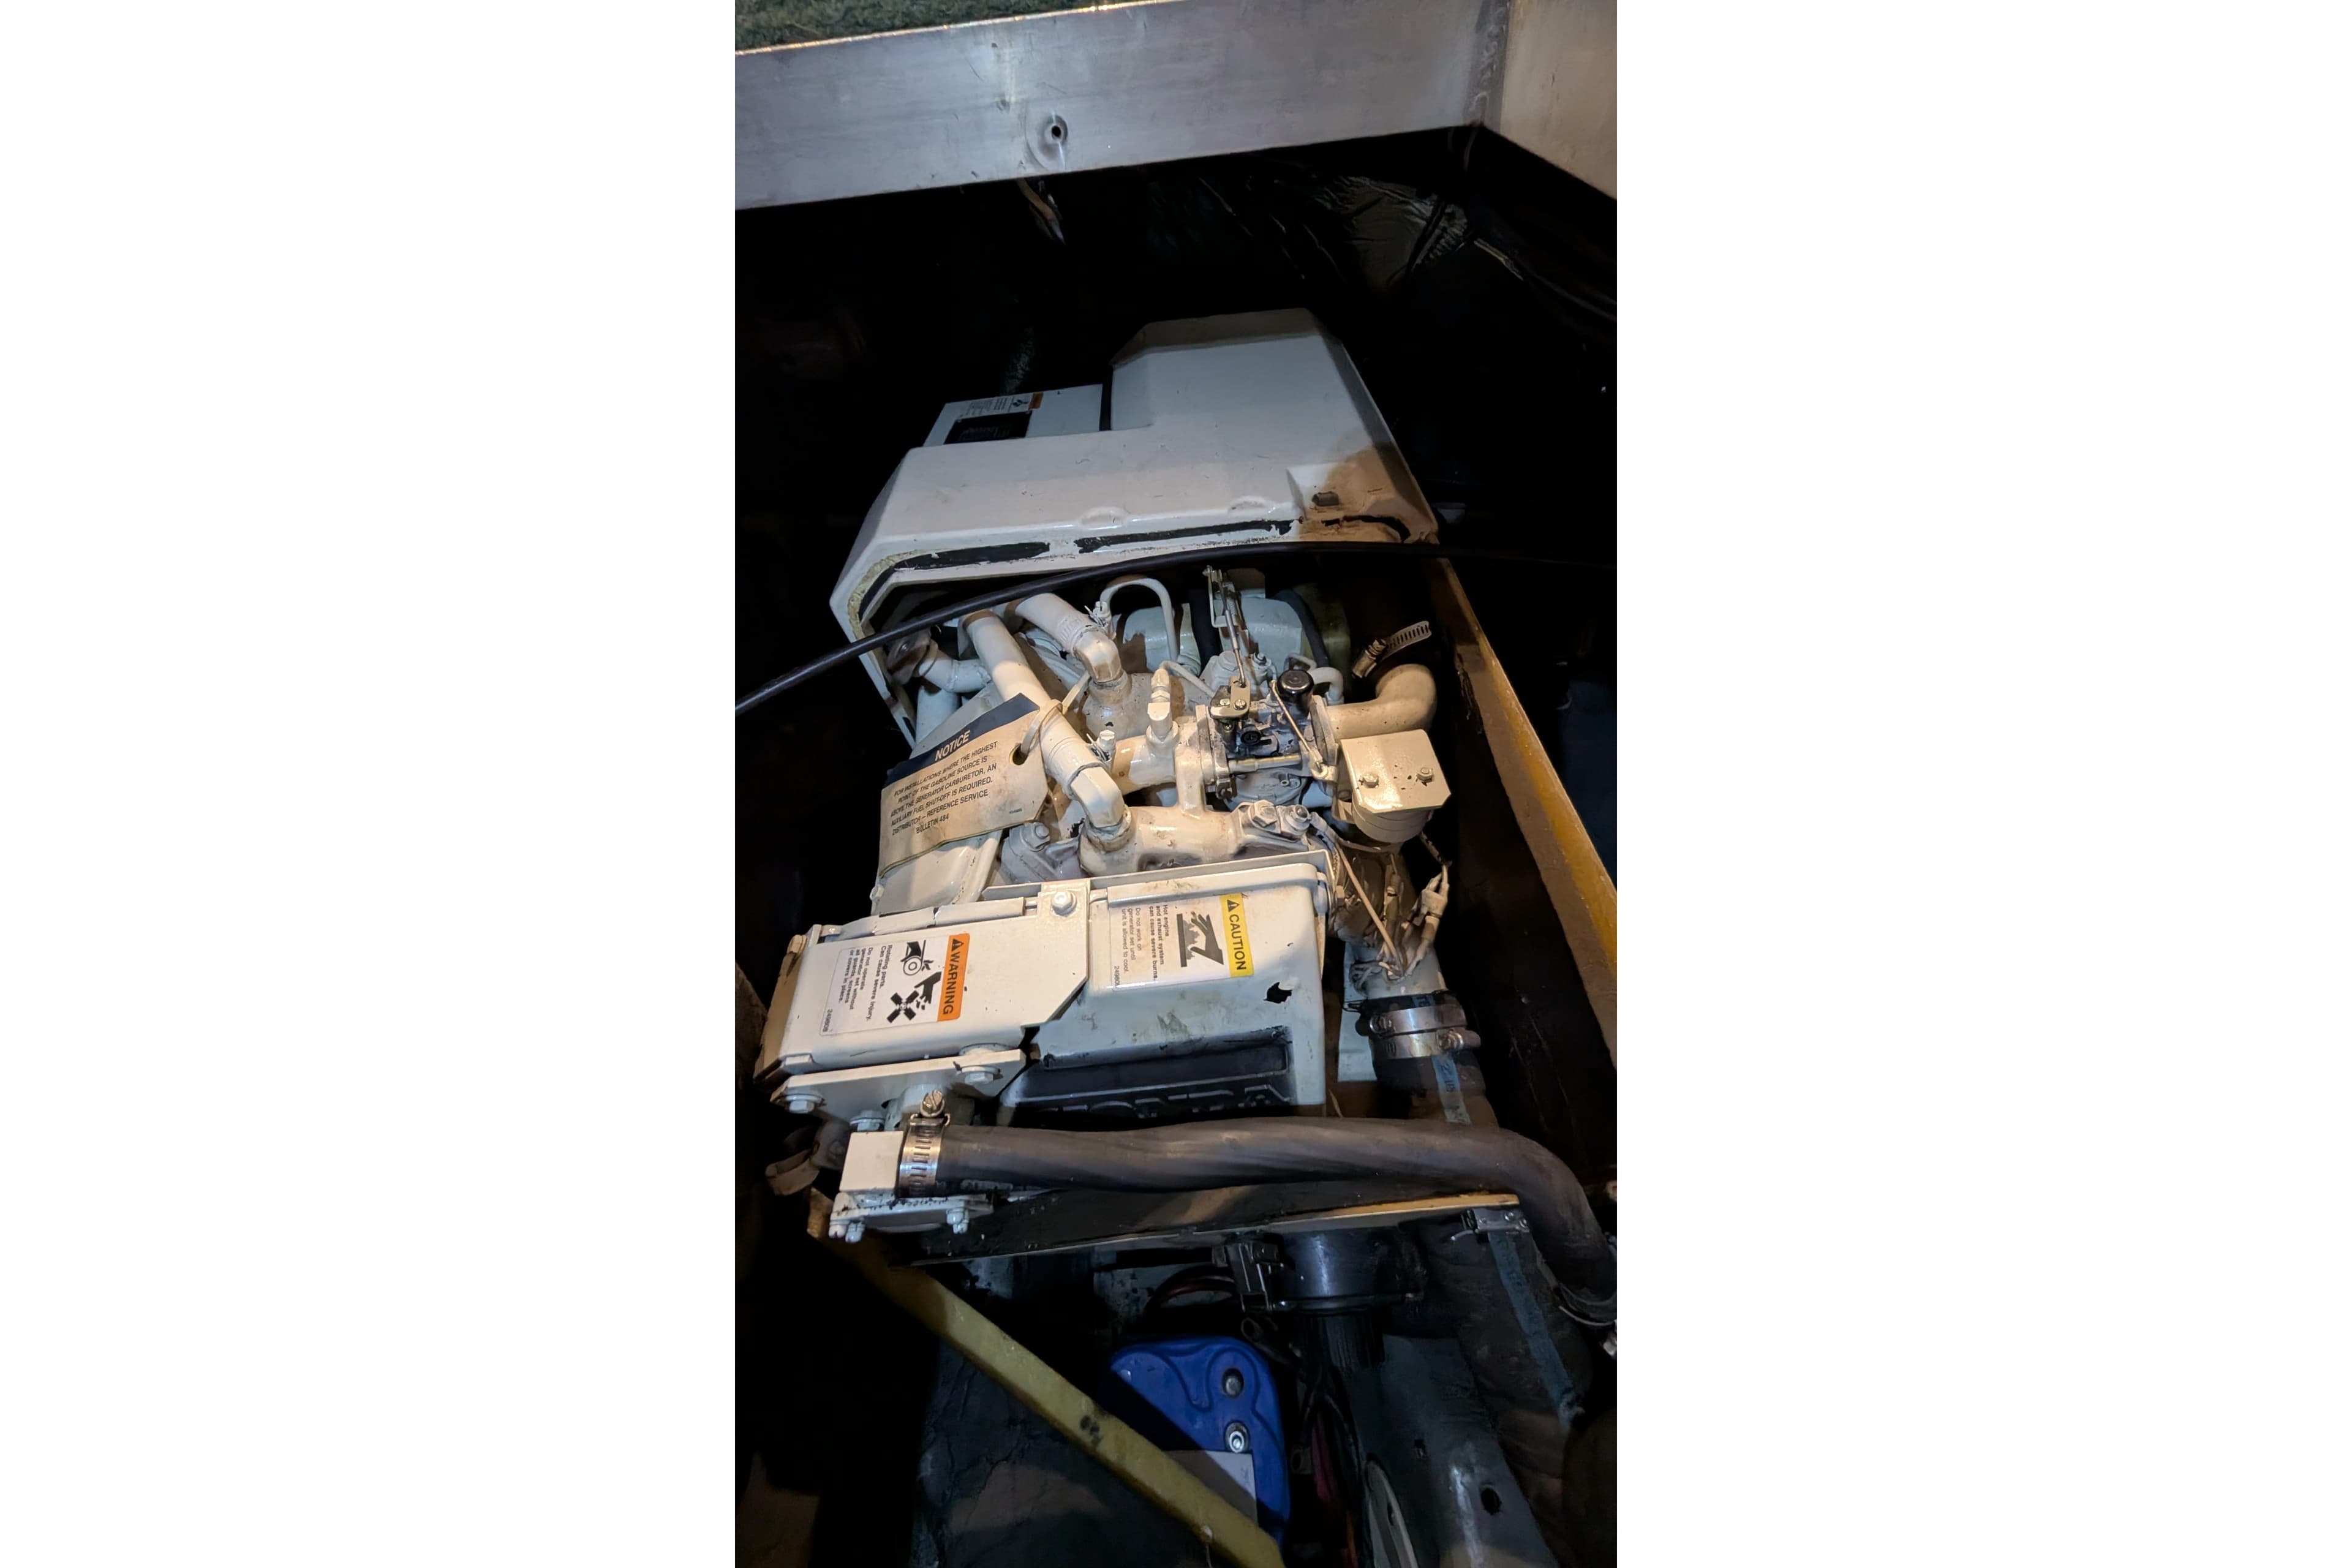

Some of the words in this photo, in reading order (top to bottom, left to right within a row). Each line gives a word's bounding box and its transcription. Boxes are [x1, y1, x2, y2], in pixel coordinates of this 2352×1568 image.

[935, 730, 970, 761] NOTICE
[960, 753, 970, 763] THE
[971, 741, 997, 758] HIGHEST
[915, 785, 944, 804] GENERATOR
[944, 768, 985, 789] CARBURETOR,
[987, 763, 997, 772] AN
[931, 770, 956, 787] GASOLINE
[957, 759, 980, 774] SOURCE
[913, 804, 924, 814] FUEL
[959, 776, 992, 793] REQUIRED.
[927, 798, 959, 817] REFERENCE
[960, 789, 988, 804] SERVICE
[916, 817, 939, 834] BULLETIN
[1136, 907, 1140, 916] Do
[1229, 914, 1246, 970] CAUTION
[844, 957, 853, 976] covers
[857, 948, 866, 975] generator
[883, 944, 892, 970] Rotating
[859, 968, 869, 990] operate
[871, 979, 880, 999] severe
[879, 971, 888, 989] parts.
[943, 952, 960, 1015] WARNING
[839, 985, 847, 1004] place.
[845, 980, 854, 1004] screens
[850, 988, 859, 1010] without
[866, 1001, 876, 1022] injury.
